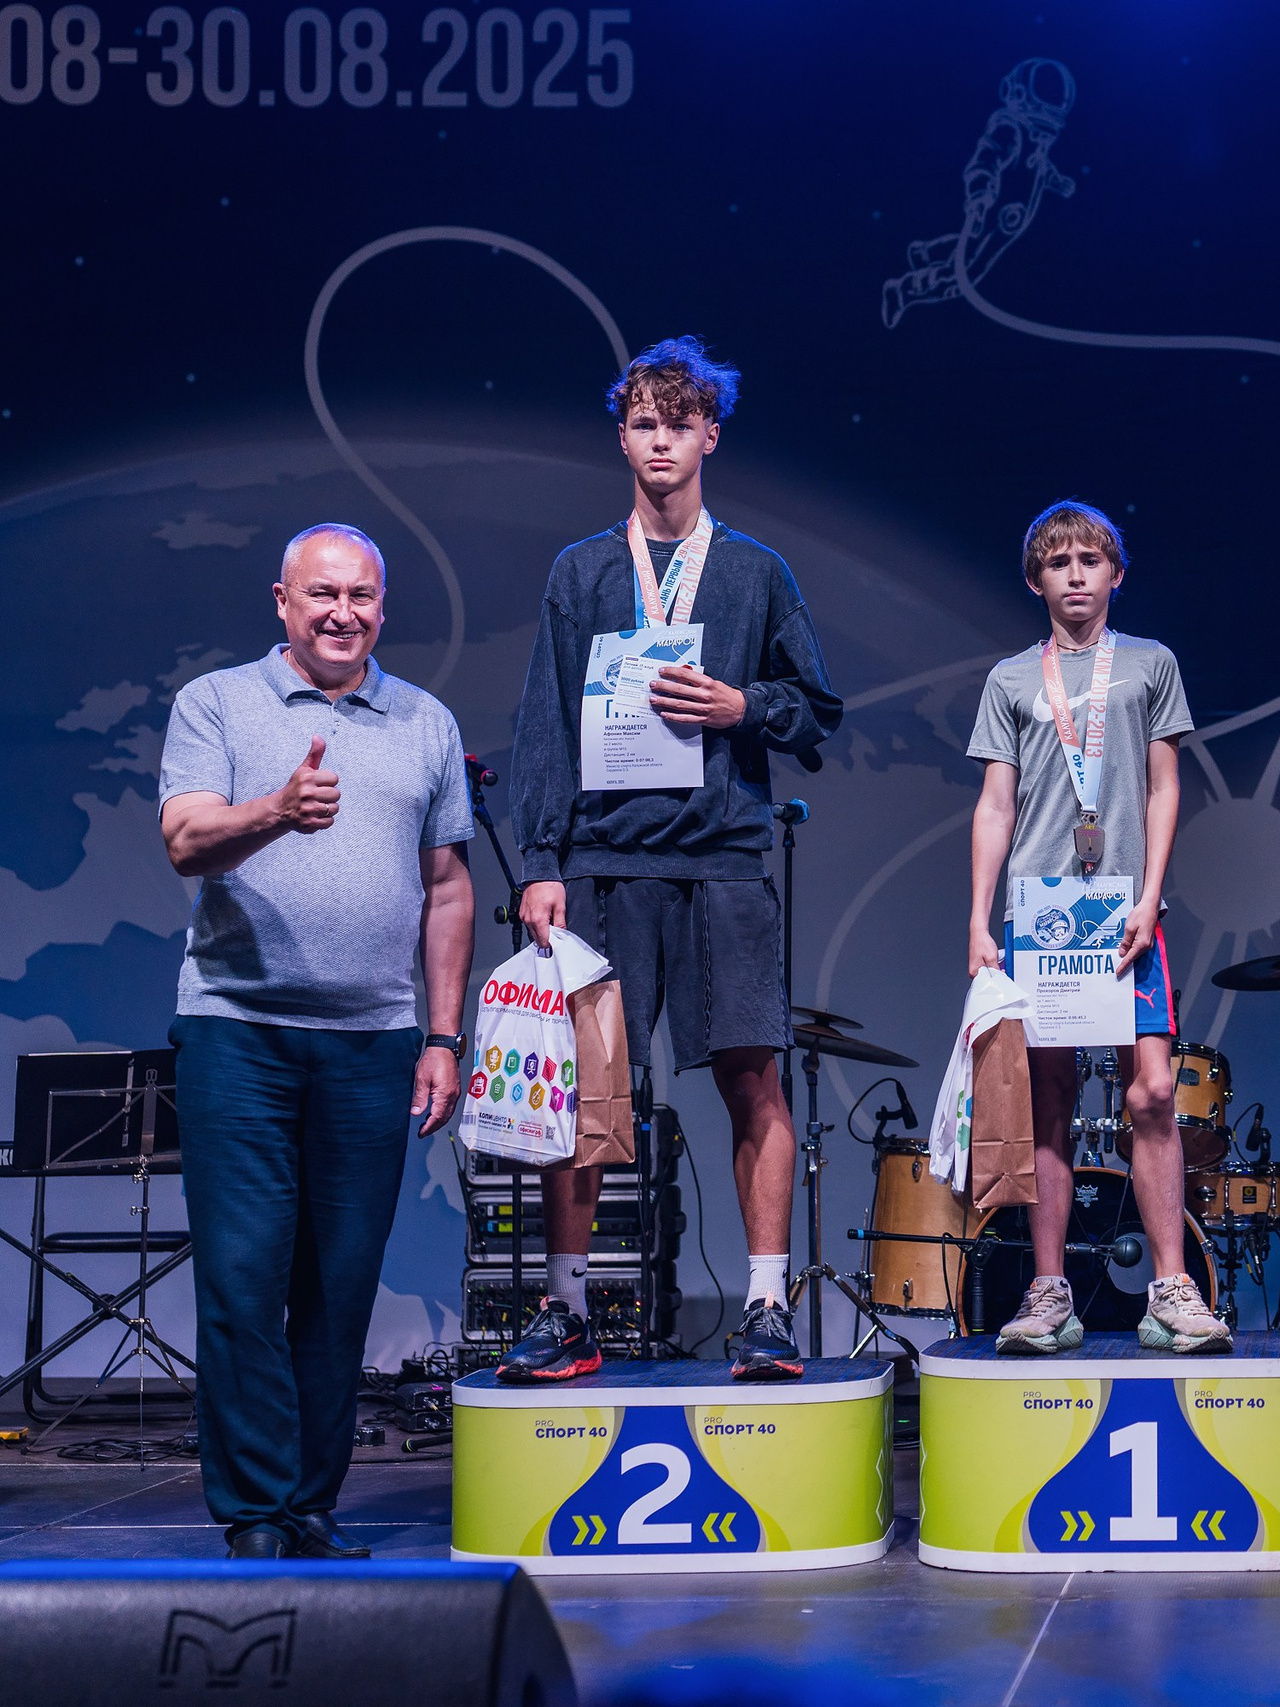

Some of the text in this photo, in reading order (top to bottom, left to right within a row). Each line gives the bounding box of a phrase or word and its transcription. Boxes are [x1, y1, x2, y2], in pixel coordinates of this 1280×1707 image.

[0, 4, 634, 107] 08-30.08.2025
[664, 559, 684, 588] ПЕРВЫМ
[671, 557, 703, 626] 2012-201
[1085, 678, 1109, 758] 2012-2013
[1072, 754, 1082, 768] 40
[1085, 892, 1126, 900] МАРАФОН
[1038, 954, 1115, 975] ГРАМОТА
[479, 1112, 508, 1124] копицентр
[1023, 1399, 1094, 1410] СПОРТ 40
[1195, 1398, 1265, 1409] СПОРТ 40
[535, 1419, 554, 1427] PRO
[704, 1416, 723, 1424] PRO
[535, 1426, 607, 1439] СПОРТ 40
[704, 1423, 776, 1436] СПОРТ 40
[1110, 1421, 1178, 1541] 1
[618, 1442, 692, 1545] 2
